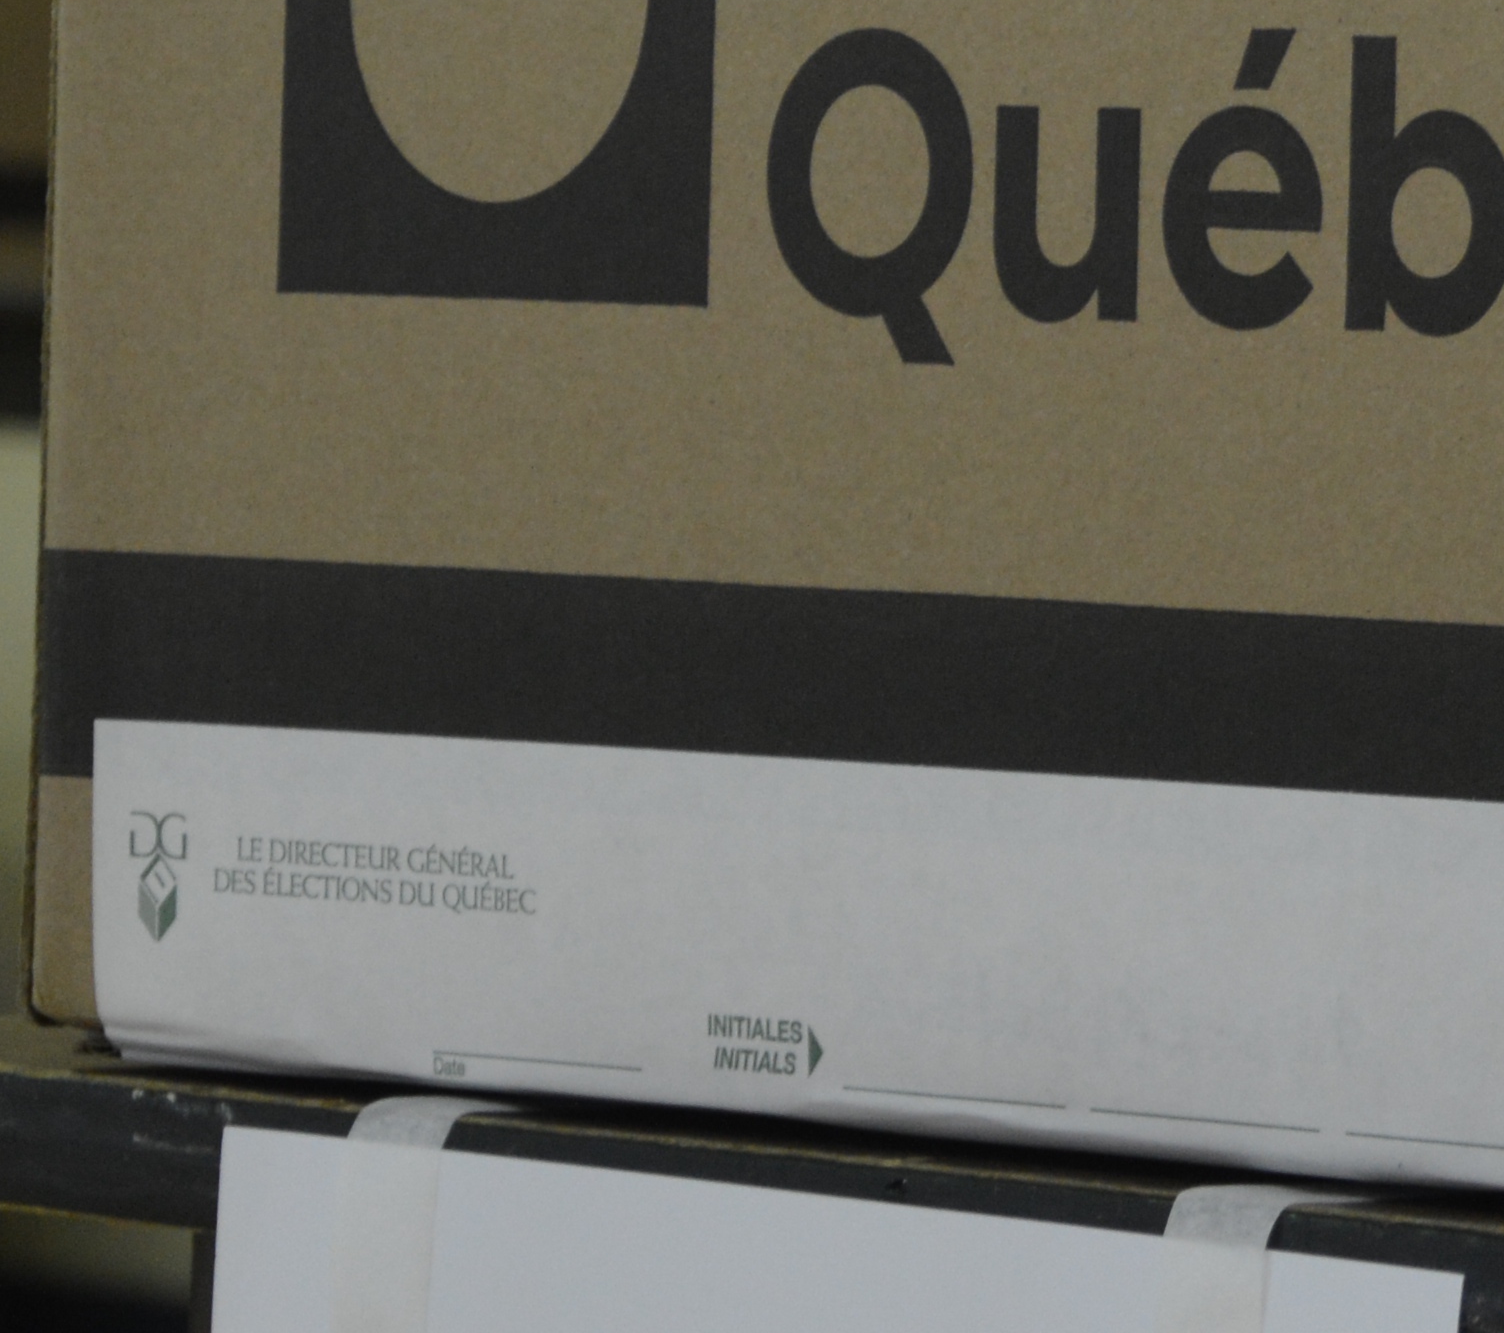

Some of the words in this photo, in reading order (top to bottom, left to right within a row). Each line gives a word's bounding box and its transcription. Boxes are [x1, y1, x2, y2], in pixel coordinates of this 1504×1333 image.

[236, 836, 263, 863] LE
[268, 837, 401, 871] DIRECTEUR
[407, 843, 515, 880] GÉNÉRAL
[213, 867, 256, 895] DES
[262, 866, 393, 905] ÉLECTIONS
[398, 880, 436, 908] DU
[442, 880, 537, 915] QUÉBEC
[707, 1012, 803, 1044] INITIALES
[432, 1055, 466, 1077] Date
[713, 1045, 796, 1076] INITIALS
